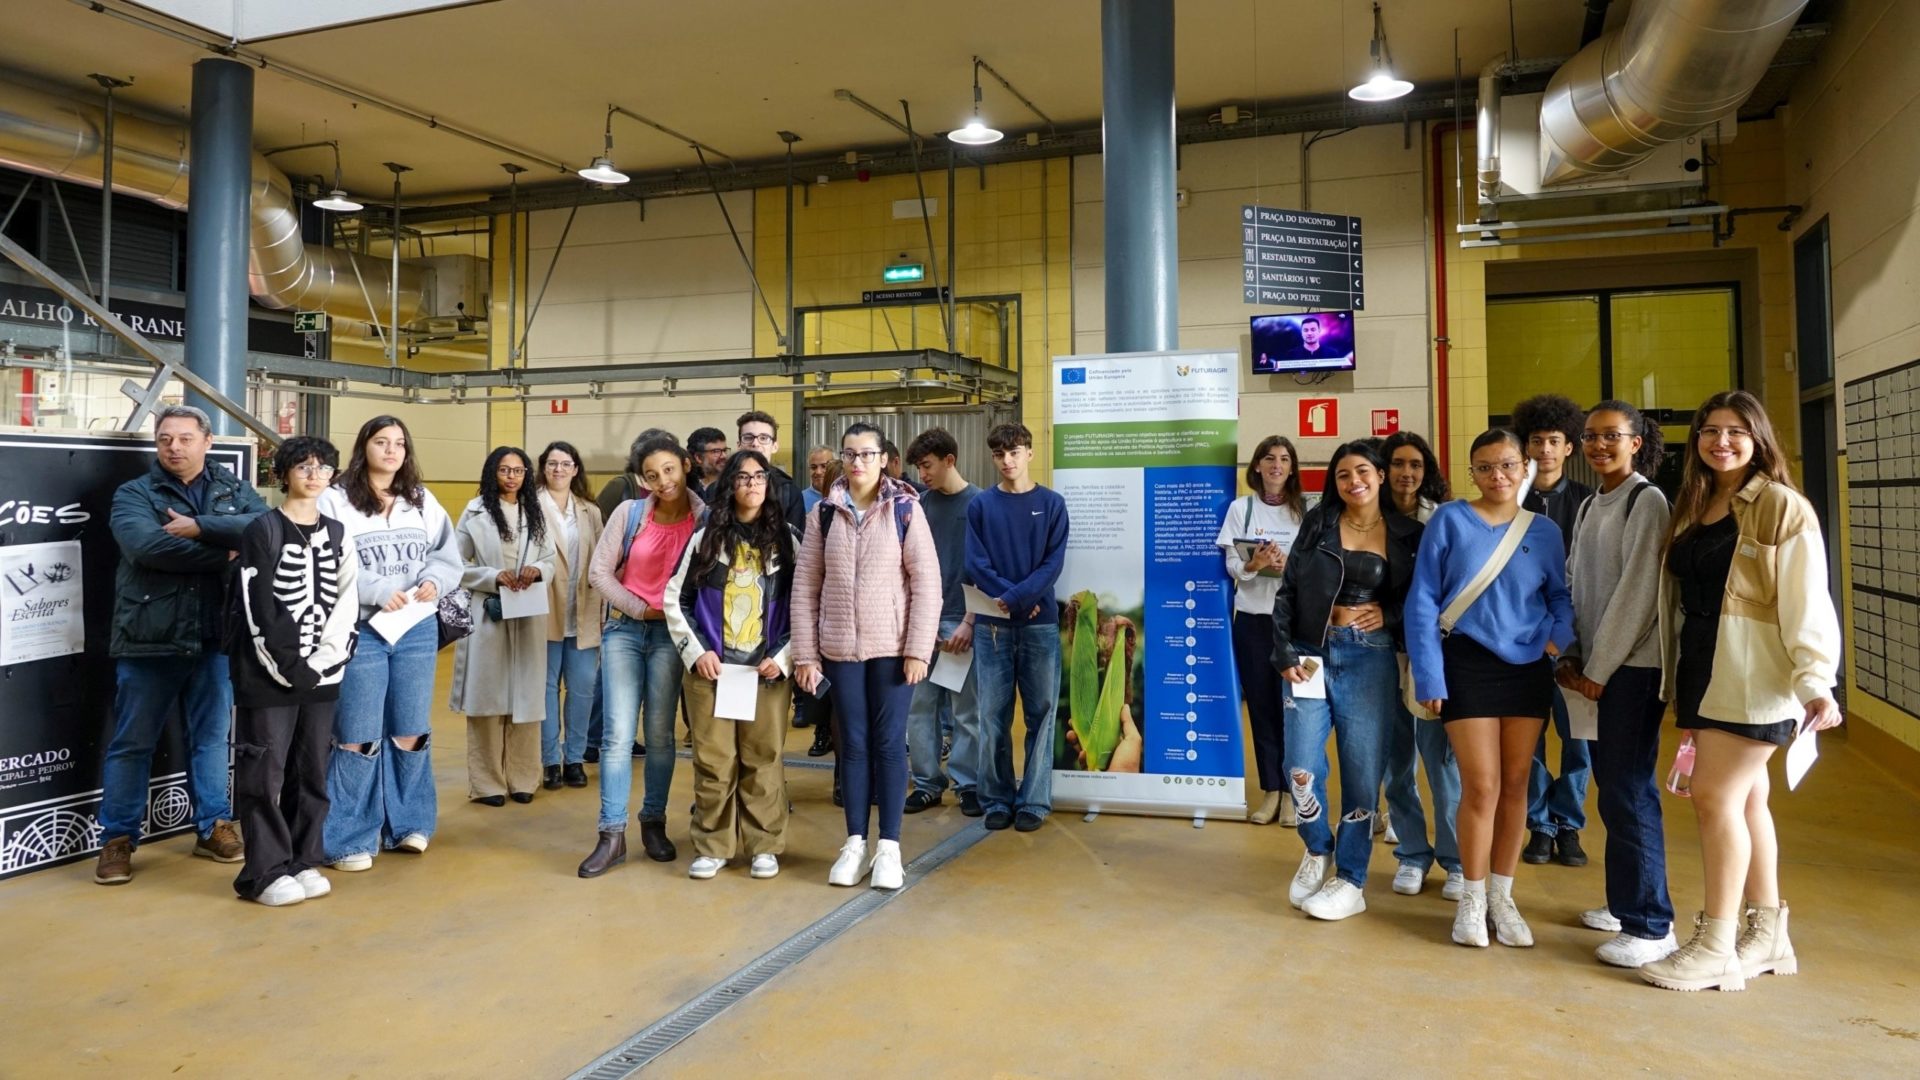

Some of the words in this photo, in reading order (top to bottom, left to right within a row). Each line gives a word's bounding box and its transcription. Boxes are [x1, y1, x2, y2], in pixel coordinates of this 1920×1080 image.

[1261, 212, 1284, 222] PRAÇA
[1298, 216, 1336, 226] ENCONTRO
[1261, 233, 1284, 243] PRAÇA
[1298, 237, 1347, 249] RESTAURAÇÃO
[1262, 253, 1316, 264] RESTAURANTES
[1262, 273, 1304, 282] SANITÁRIOS
[1262, 291, 1286, 301] PRAÇA
[1301, 294, 1320, 302] PEIXE
[382, 564, 409, 576] 1996
[24, 597, 70, 612] Sabores
[11, 606, 55, 621] Escrita
